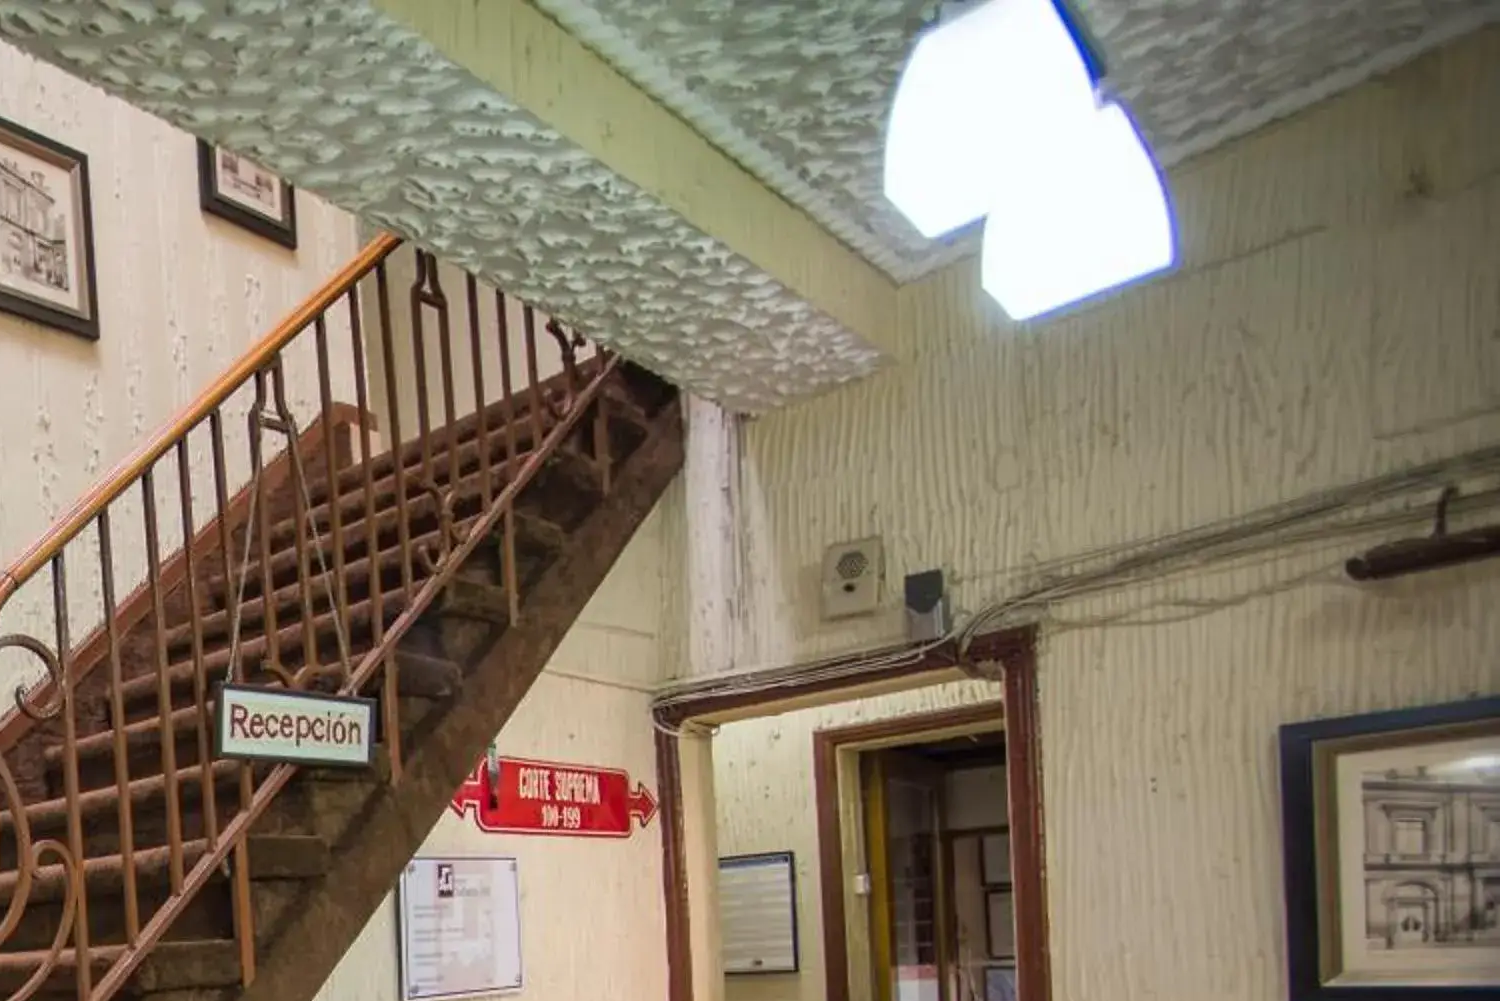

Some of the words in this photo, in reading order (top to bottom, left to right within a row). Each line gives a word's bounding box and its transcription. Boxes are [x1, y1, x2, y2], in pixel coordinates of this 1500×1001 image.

[230, 703, 361, 747] Recepción
[519, 767, 551, 801] CORTE
[554, 770, 601, 805] SUPREMA
[541, 803, 581, 829] 100-199
